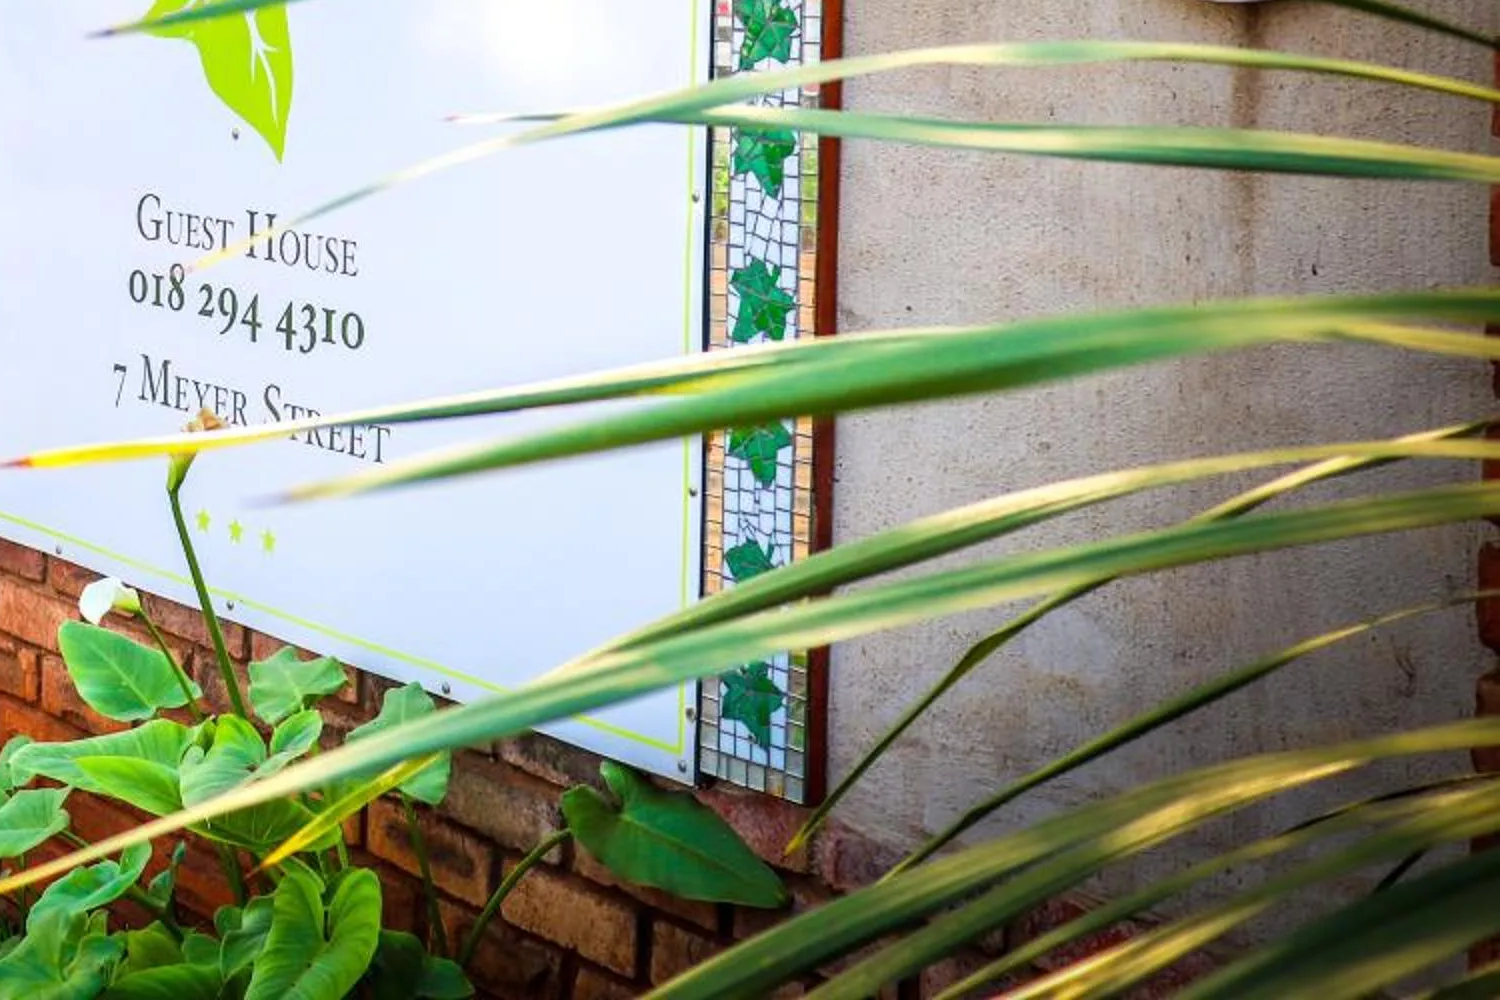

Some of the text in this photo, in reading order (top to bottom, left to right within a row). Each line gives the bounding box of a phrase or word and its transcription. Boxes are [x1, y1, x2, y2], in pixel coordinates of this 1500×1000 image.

[129, 263, 365, 354] 018 294 4310
[113, 363, 128, 408] 7
